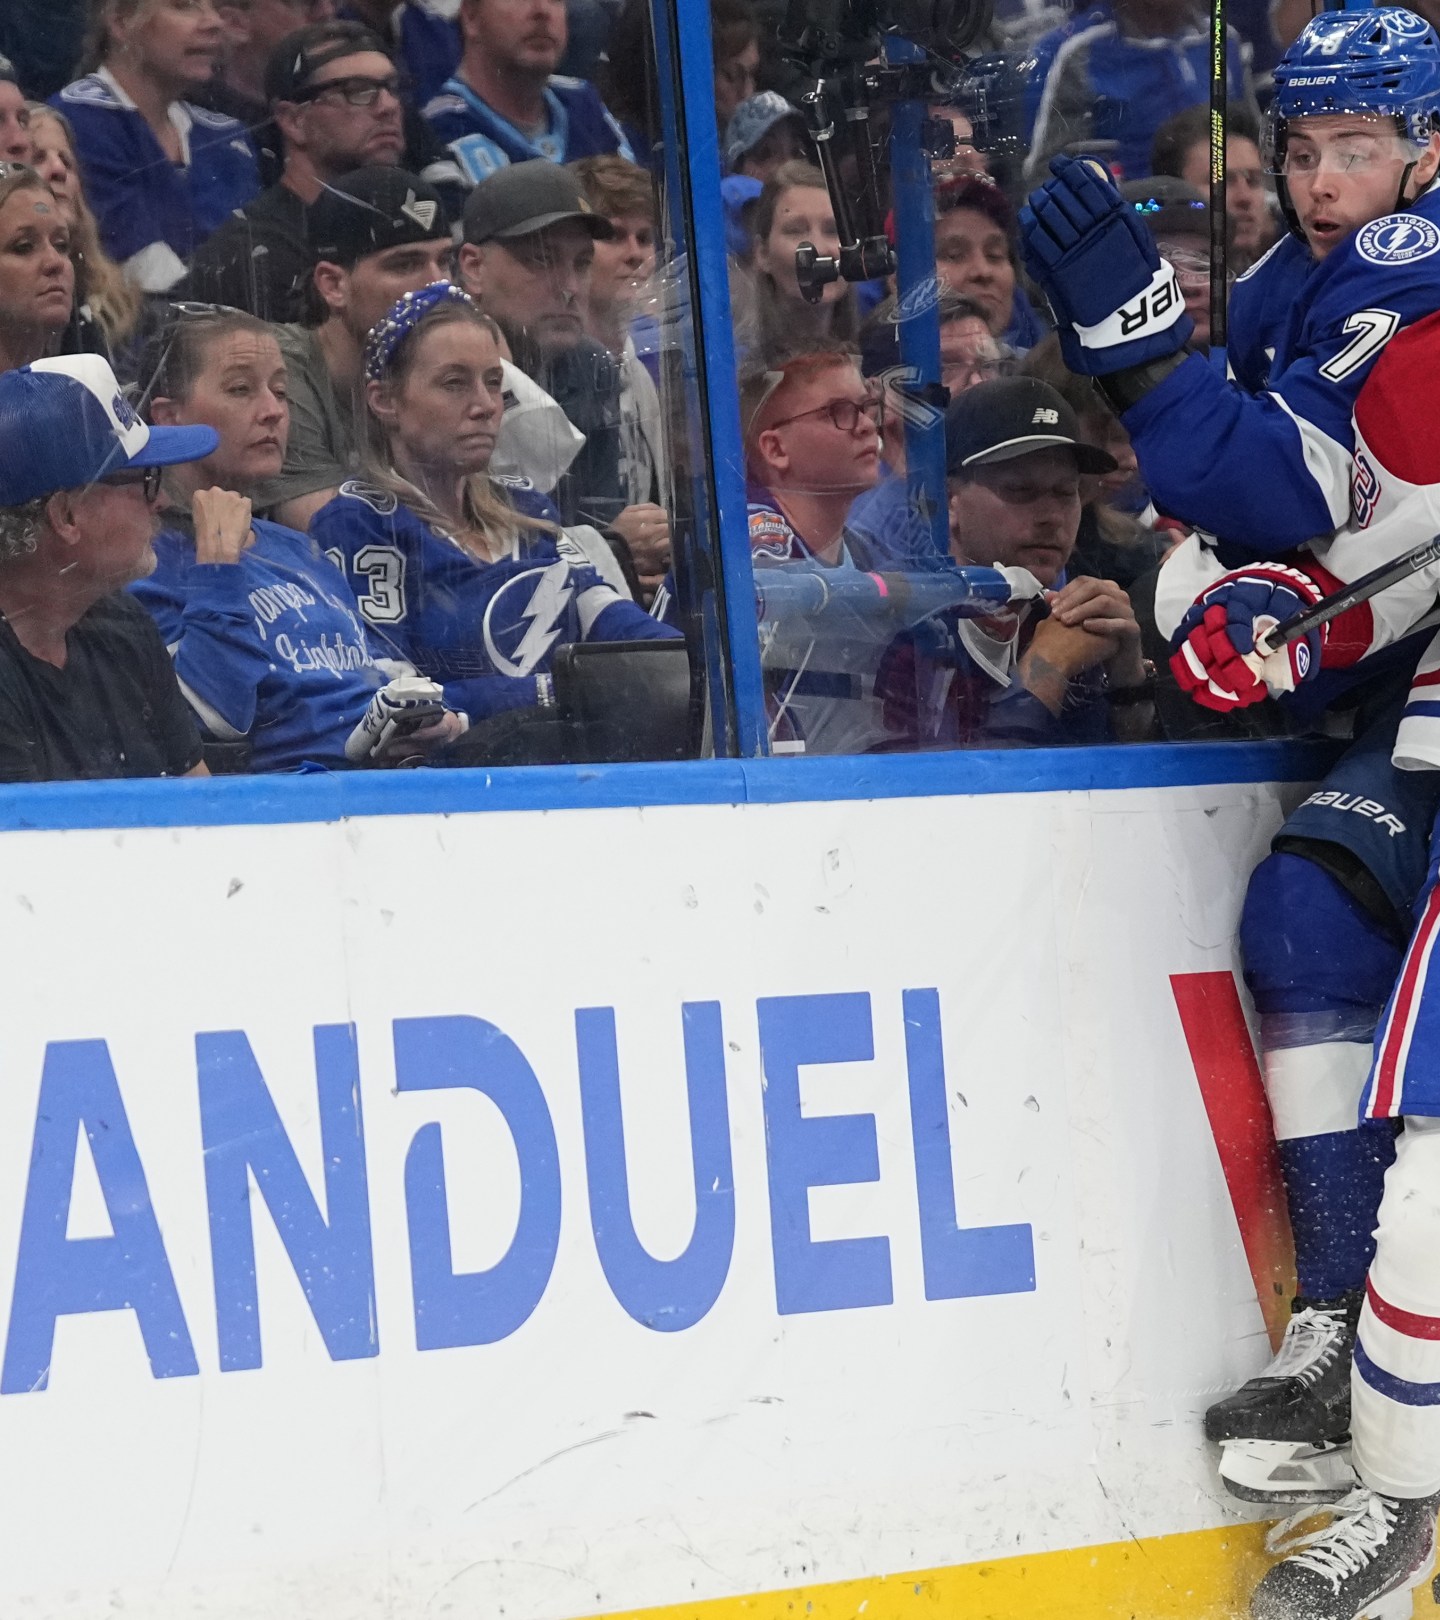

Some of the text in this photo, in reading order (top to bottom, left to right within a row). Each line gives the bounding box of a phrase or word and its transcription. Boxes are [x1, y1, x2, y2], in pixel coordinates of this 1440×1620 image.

[1288, 75, 1337, 87] BAUER
[1362, 216, 1437, 258] TAMPA BAY LIGHTNING
[1318, 307, 1403, 384] 7
[1299, 790, 1408, 838] BAUER
